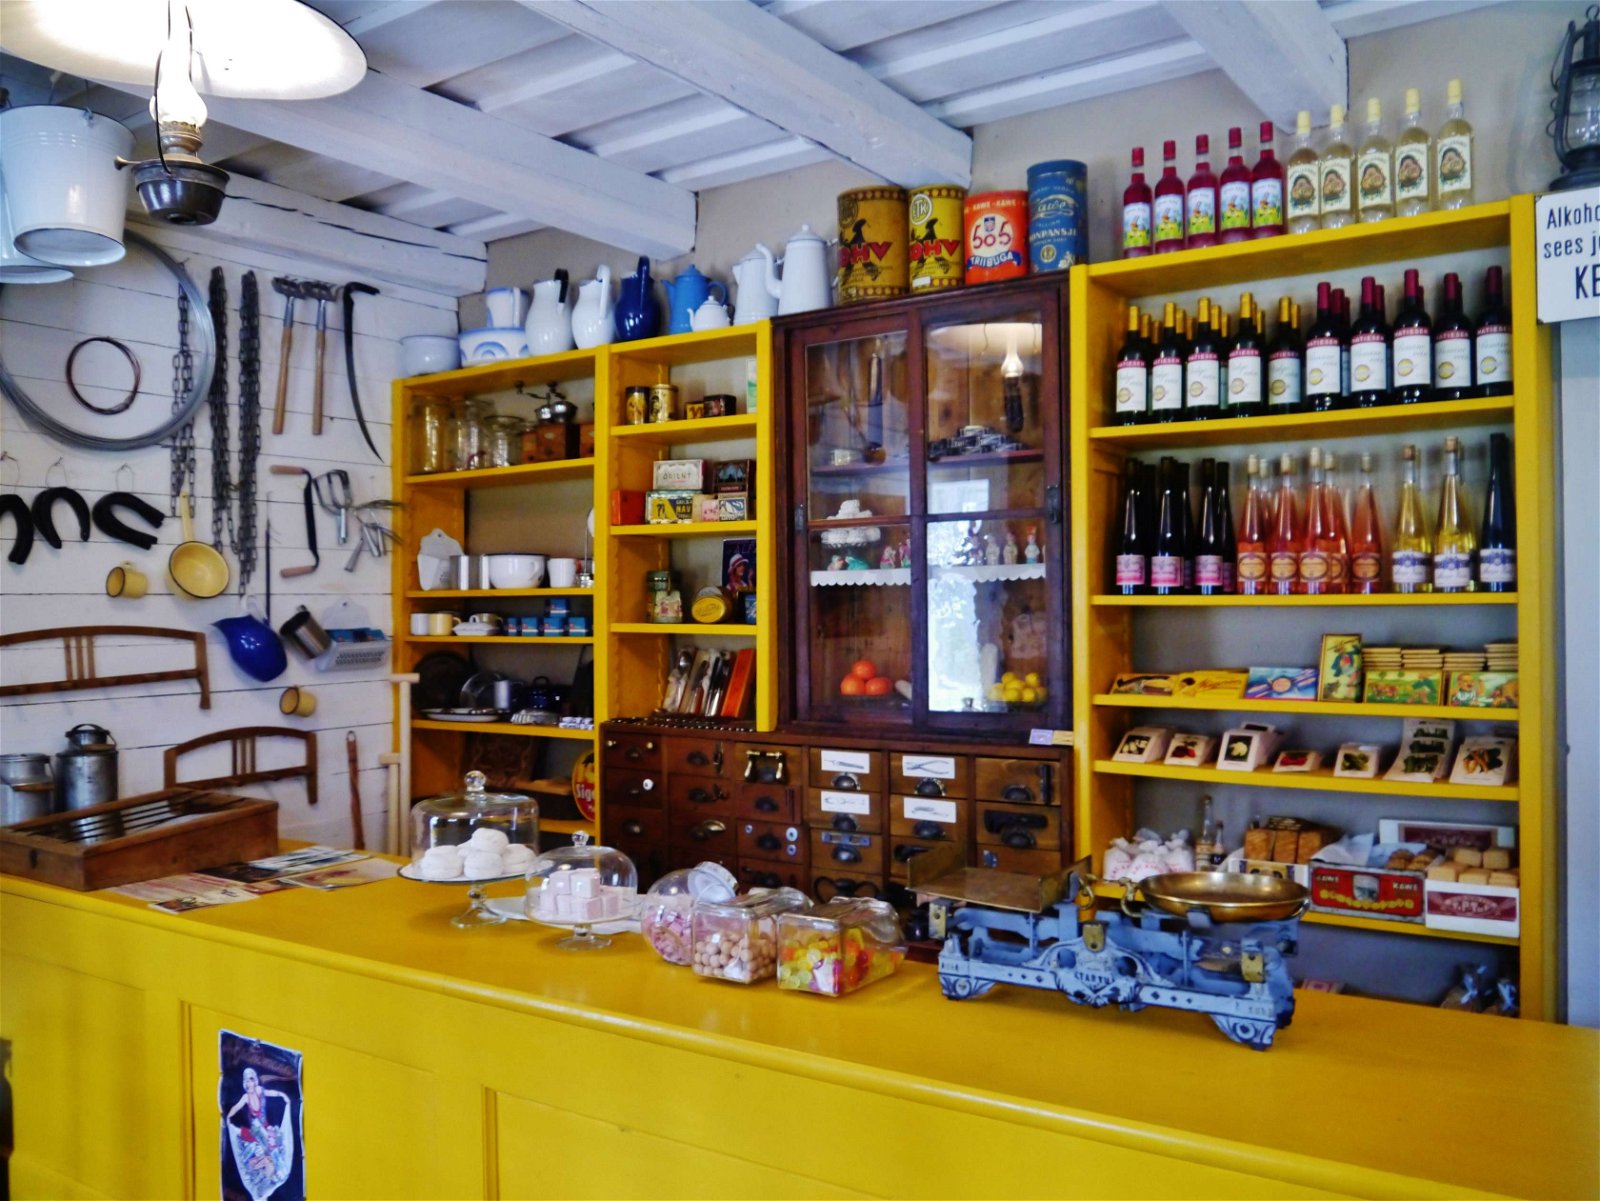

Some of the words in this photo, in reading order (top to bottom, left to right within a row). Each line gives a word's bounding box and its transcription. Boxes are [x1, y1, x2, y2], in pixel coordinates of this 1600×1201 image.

[973, 221, 1011, 249] 505
[1544, 237, 1583, 259] sees
[576, 783, 595, 802] Sig
